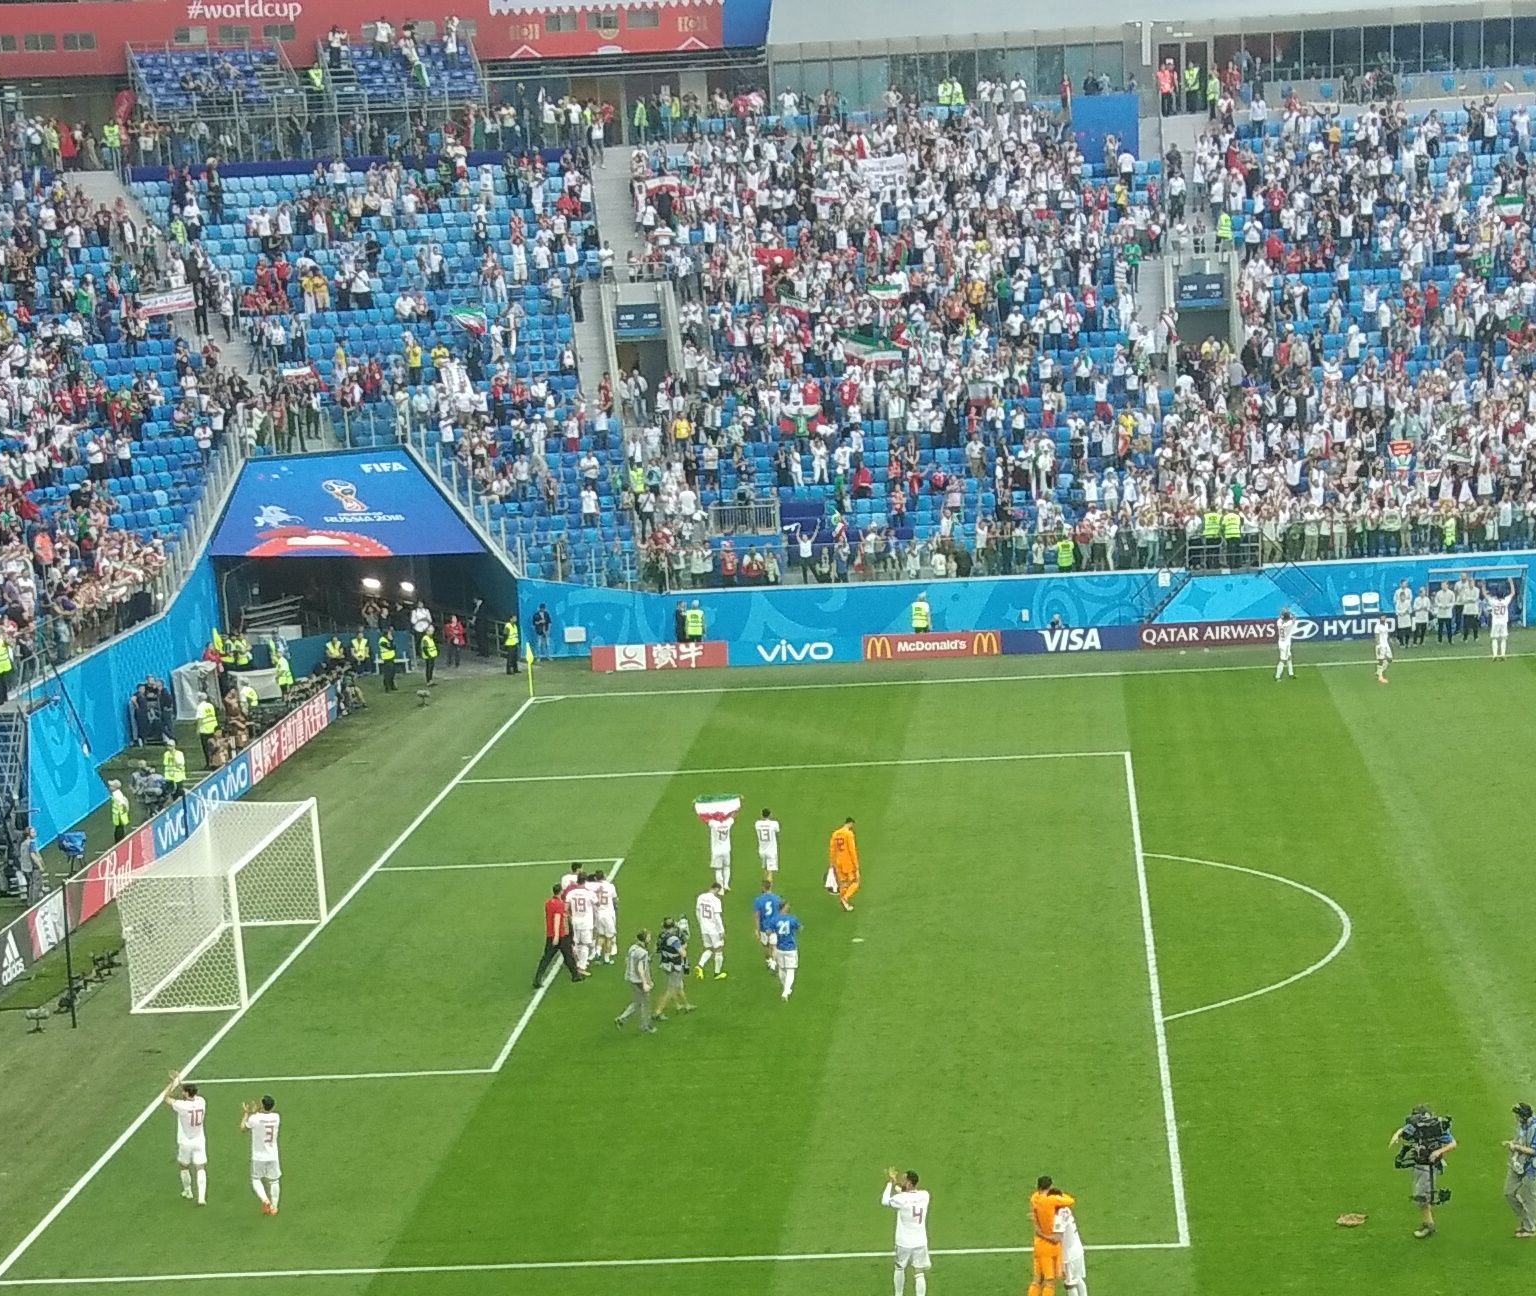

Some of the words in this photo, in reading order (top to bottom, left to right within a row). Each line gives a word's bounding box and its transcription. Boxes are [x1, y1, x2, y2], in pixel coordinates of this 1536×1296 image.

[187, 0, 302, 21] #worldcup
[359, 462, 408, 473] FIFA
[1038, 629, 1102, 651] VISA
[1142, 627, 1200, 644] QATAR
[1203, 623, 1276, 641] AIRWAYS
[757, 639, 834, 661] vivo
[897, 638, 967, 653] McDonald's
[651, 643, 703, 670] 蒙牛
[220, 762, 248, 801] vivo
[98, 839, 133, 904] Bud
[572, 897, 585, 913] 19
[701, 904, 712, 919] 15
[777, 920, 791, 935] 21
[1, 957, 24, 986] adidas
[187, 1109, 204, 1127] 10
[912, 1206, 923, 1224] 4
